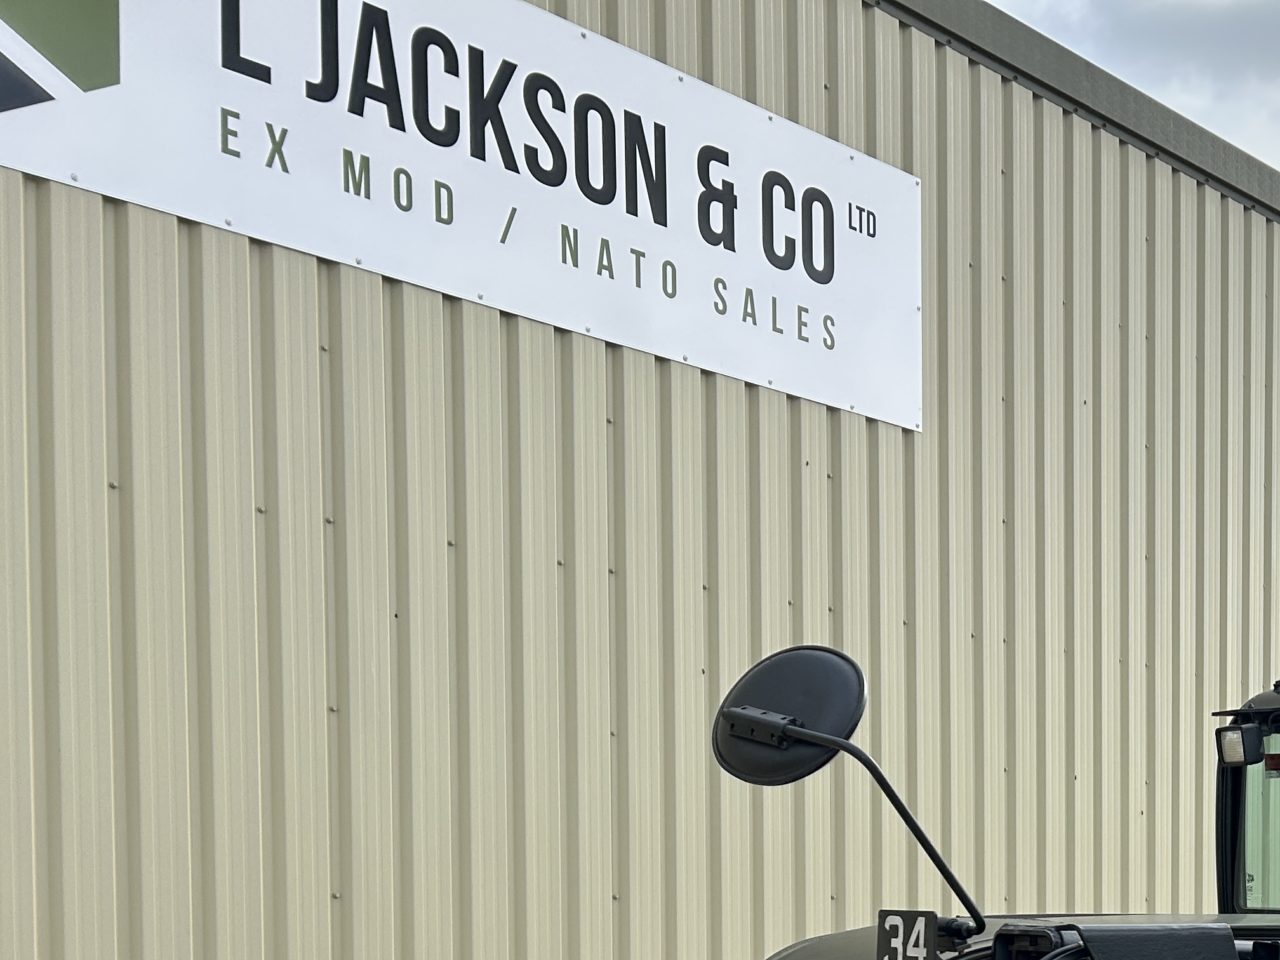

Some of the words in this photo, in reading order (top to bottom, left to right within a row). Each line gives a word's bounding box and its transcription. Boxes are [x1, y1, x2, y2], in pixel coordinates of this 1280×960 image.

[220, 0, 272, 85] L
[304, 0, 668, 228] JACKSON
[696, 144, 738, 253] &
[761, 170, 835, 285] CO
[847, 202, 877, 238] LTD
[220, 106, 290, 174] EX
[342, 147, 454, 225] MOD
[560, 223, 677, 299] NATO
[713, 277, 836, 350] SALES
